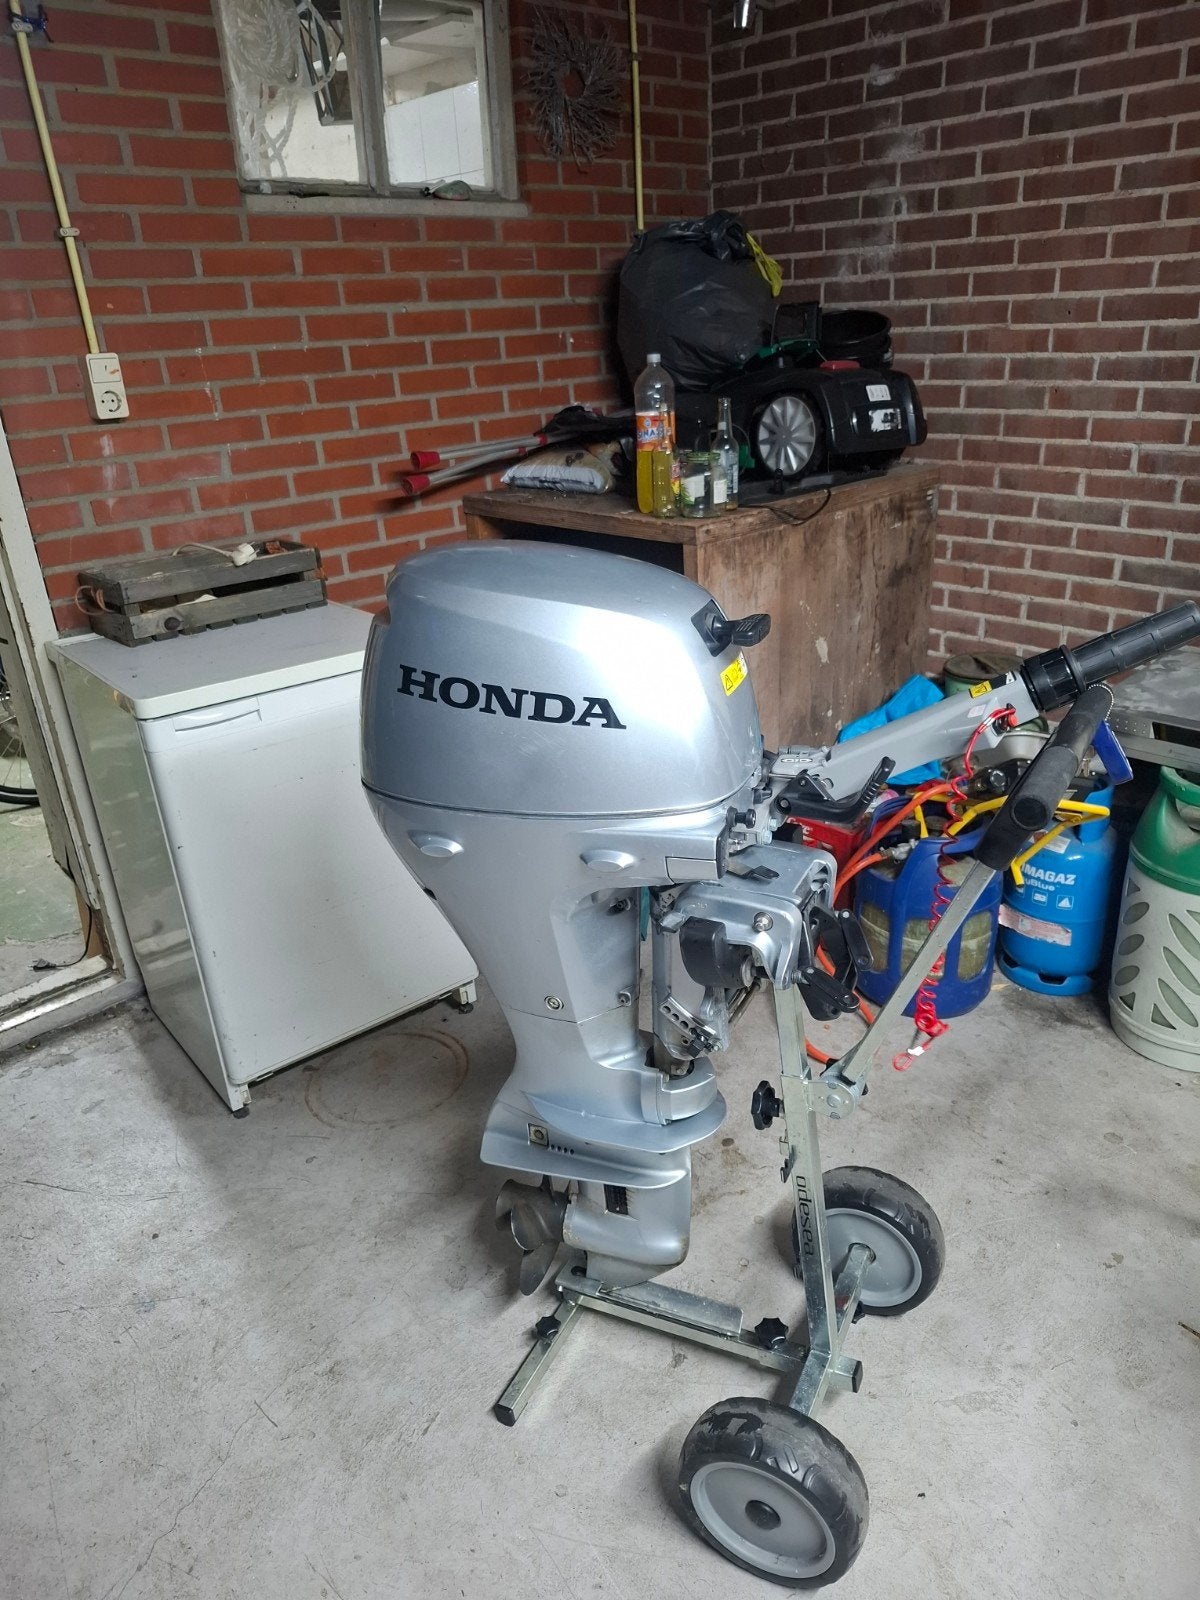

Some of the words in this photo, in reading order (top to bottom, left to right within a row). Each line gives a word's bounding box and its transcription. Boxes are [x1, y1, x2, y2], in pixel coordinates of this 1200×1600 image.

[397, 664, 627, 730] HONDA
[1021, 863, 1077, 886] IMAGAZ
[795, 1175, 814, 1256] odesea
